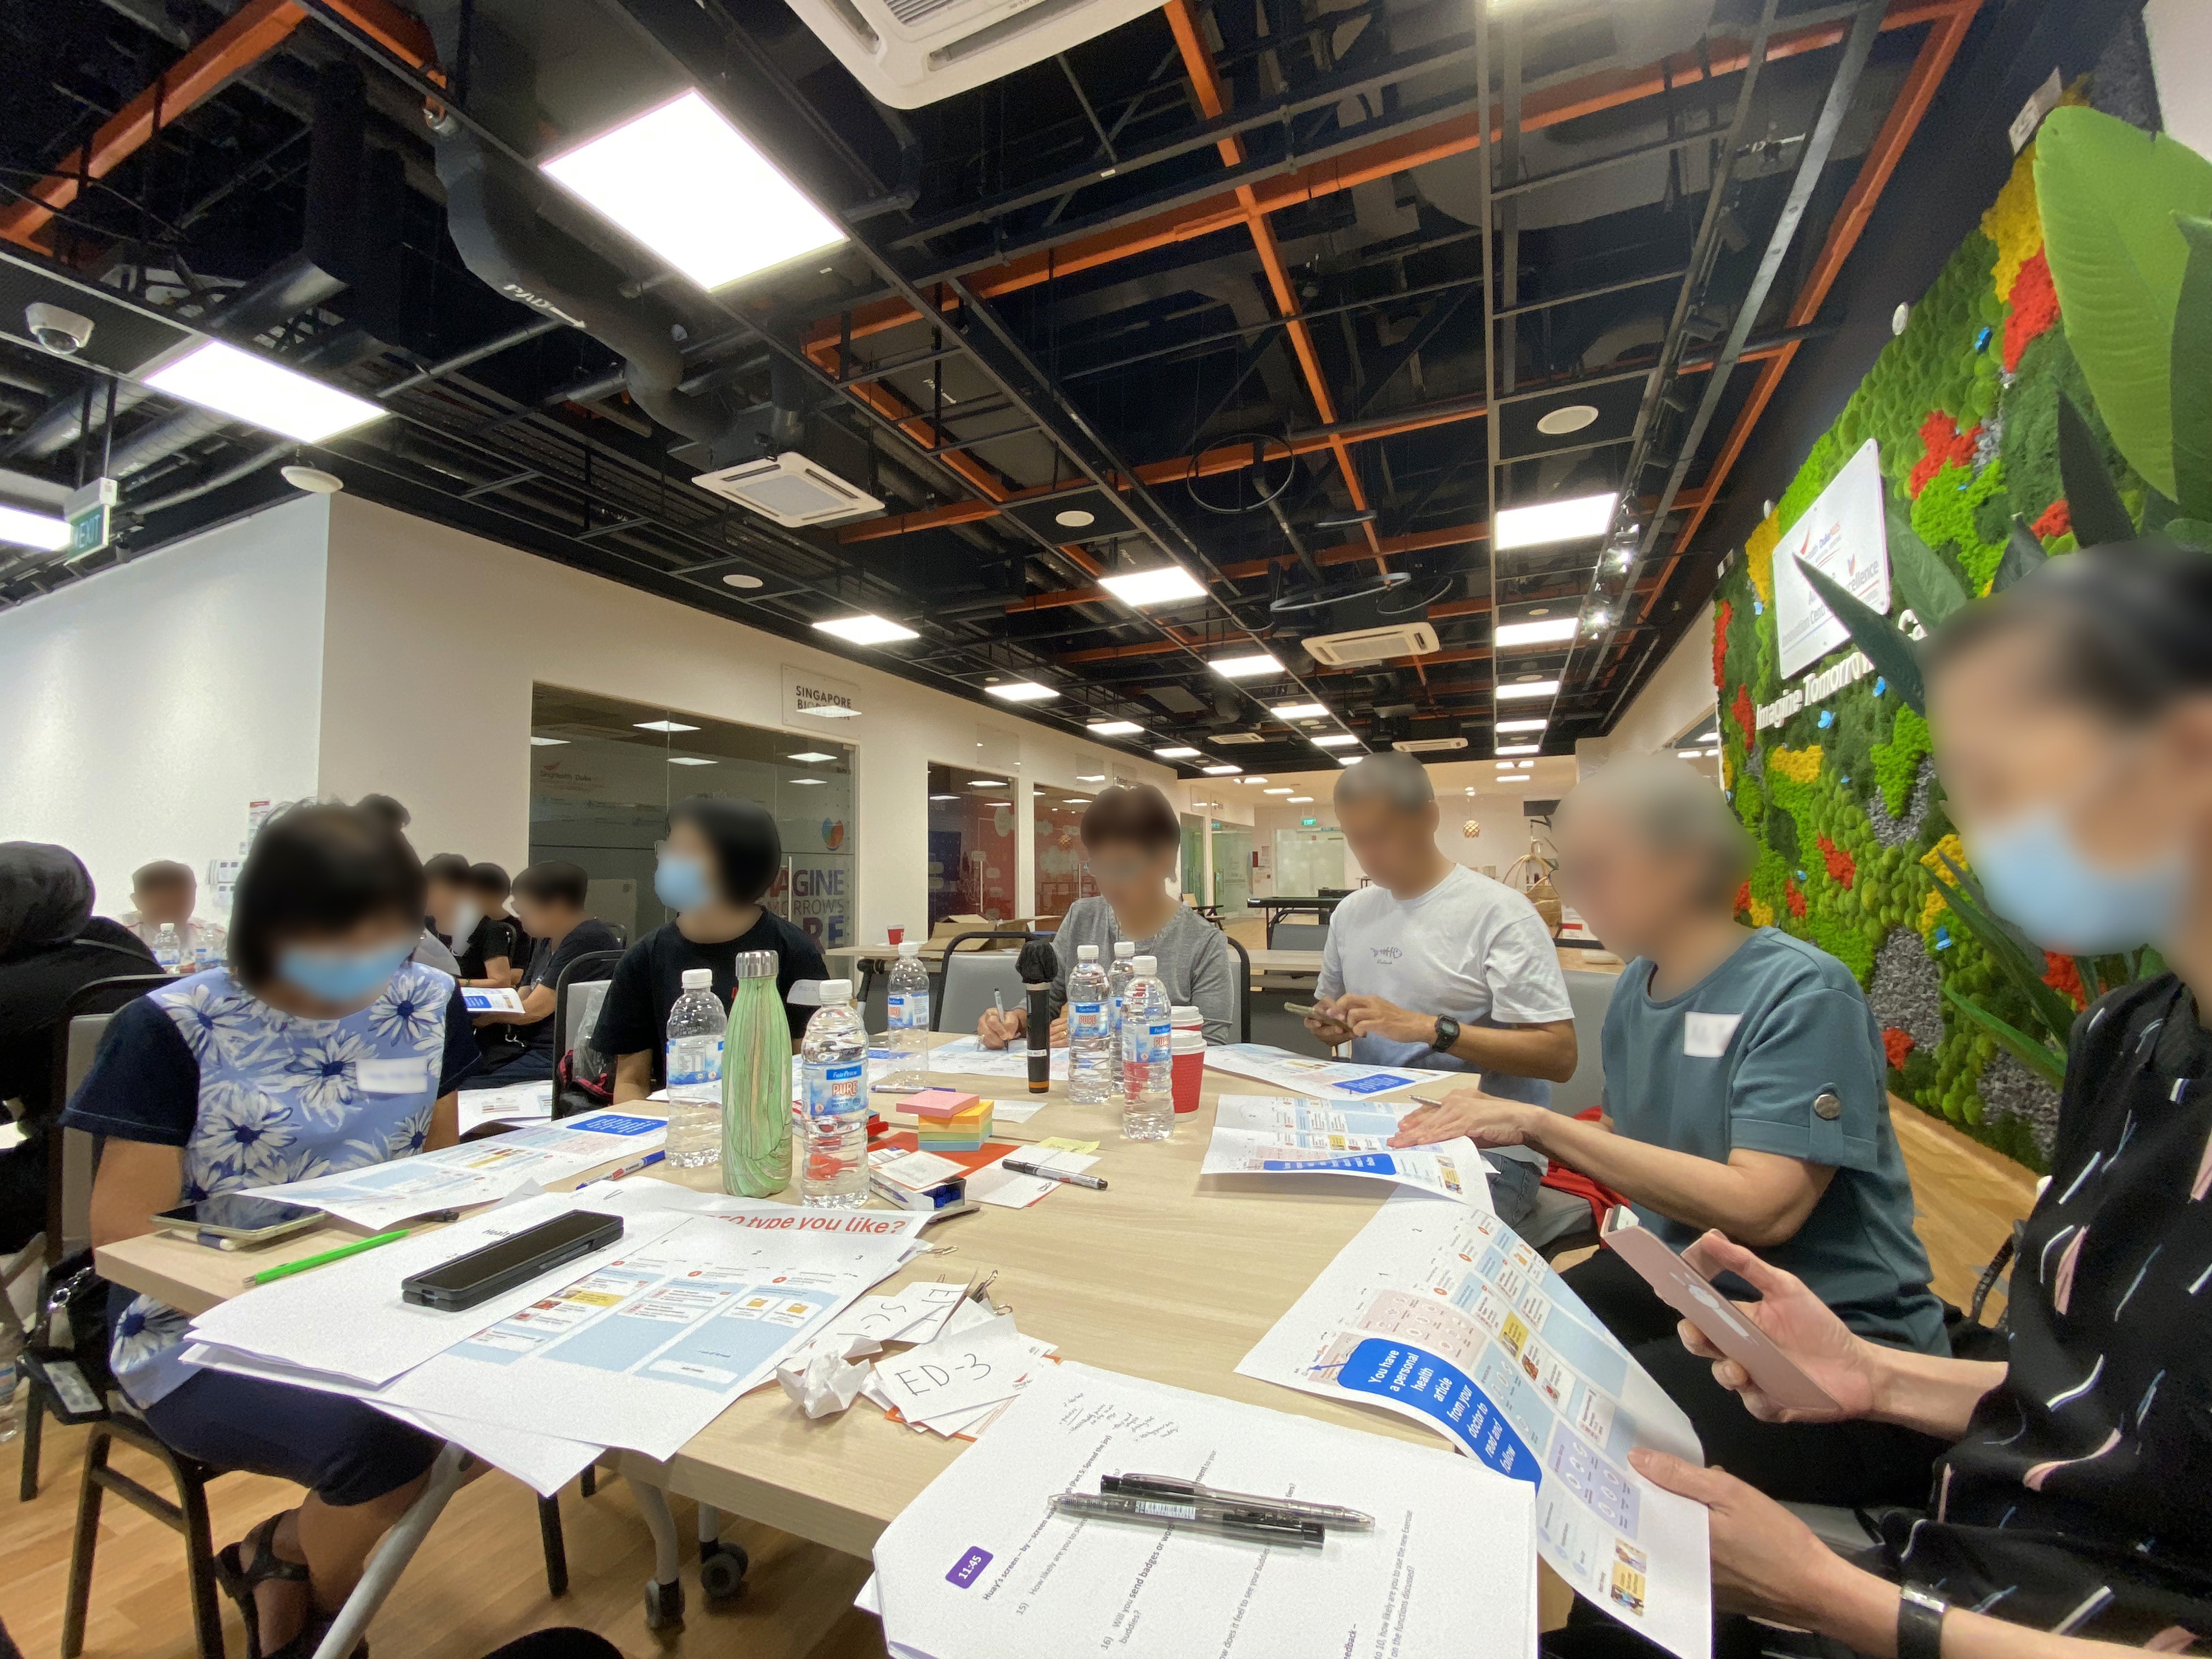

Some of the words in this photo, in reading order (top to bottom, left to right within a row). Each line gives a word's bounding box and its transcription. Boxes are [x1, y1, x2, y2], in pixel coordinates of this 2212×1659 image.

[796, 685, 851, 708] SINGAPORE
[1756, 689, 1803, 730] Imagine
[769, 867, 844, 898] AGINE
[767, 898, 845, 916] MORROW'S
[803, 915, 844, 953] RE
[1079, 1015, 1097, 1026] PURE
[832, 1080, 858, 1096] PURE
[795, 1217, 843, 1230] you
[845, 1217, 906, 1234] like?
[894, 1353, 991, 1396] ED-3
[1368, 1368, 1389, 1383] You
[1379, 1350, 1400, 1368] have
[1393, 1352, 1420, 1387] personal
[1410, 1367, 1435, 1392] health
[1433, 1377, 1453, 1402] article
[1446, 1401, 1465, 1423] from
[1459, 1384, 1473, 1408] your
[1466, 1410, 1485, 1438] doctor
[1477, 1402, 1488, 1415] to
[1485, 1431, 1498, 1458] read
[1492, 1418, 1503, 1441] and
[1500, 1444, 1516, 1474] follow
[983, 1578, 1004, 1601] Huay's
[1001, 1557, 1020, 1578] screen
[1019, 1543, 1031, 1552] by
[1031, 1520, 1048, 1538] screen
[1083, 1452, 1098, 1469] Spread
[1402, 1510, 1413, 1533] Exercise
[958, 1555, 981, 1579] 11:45
[1016, 1602, 1030, 1615] 15)
[1029, 1579, 1044, 1595] How
[1040, 1562, 1057, 1578] likely
[1053, 1551, 1063, 1562] are
[1061, 1539, 1072, 1551] you
[1250, 1571, 1260, 1587] your
[1244, 1587, 1254, 1599] see
[1402, 1565, 1415, 1600] discussed?
[1101, 1636, 1114, 1650] 16)
[1112, 1613, 1126, 1628] Will
[1122, 1599, 1133, 1613] you
[1129, 1577, 1144, 1599] send
[1138, 1551, 1160, 1578] badges
[1156, 1542, 1165, 1551] or
[1240, 1599, 1249, 1607] to
[1233, 1607, 1245, 1622] feel
[1382, 1602, 1396, 1621] likely
[1394, 1600, 1408, 1632] functions
[1119, 1610, 1141, 1644] buddies?
[1223, 1629, 1237, 1649] does
[1379, 1622, 1389, 1638] how
[1392, 1633, 1402, 1646] the
[1219, 1649, 1228, 1659] ow
[1344, 1629, 1357, 1659] eedback
[1391, 1646, 1399, 1657] on
